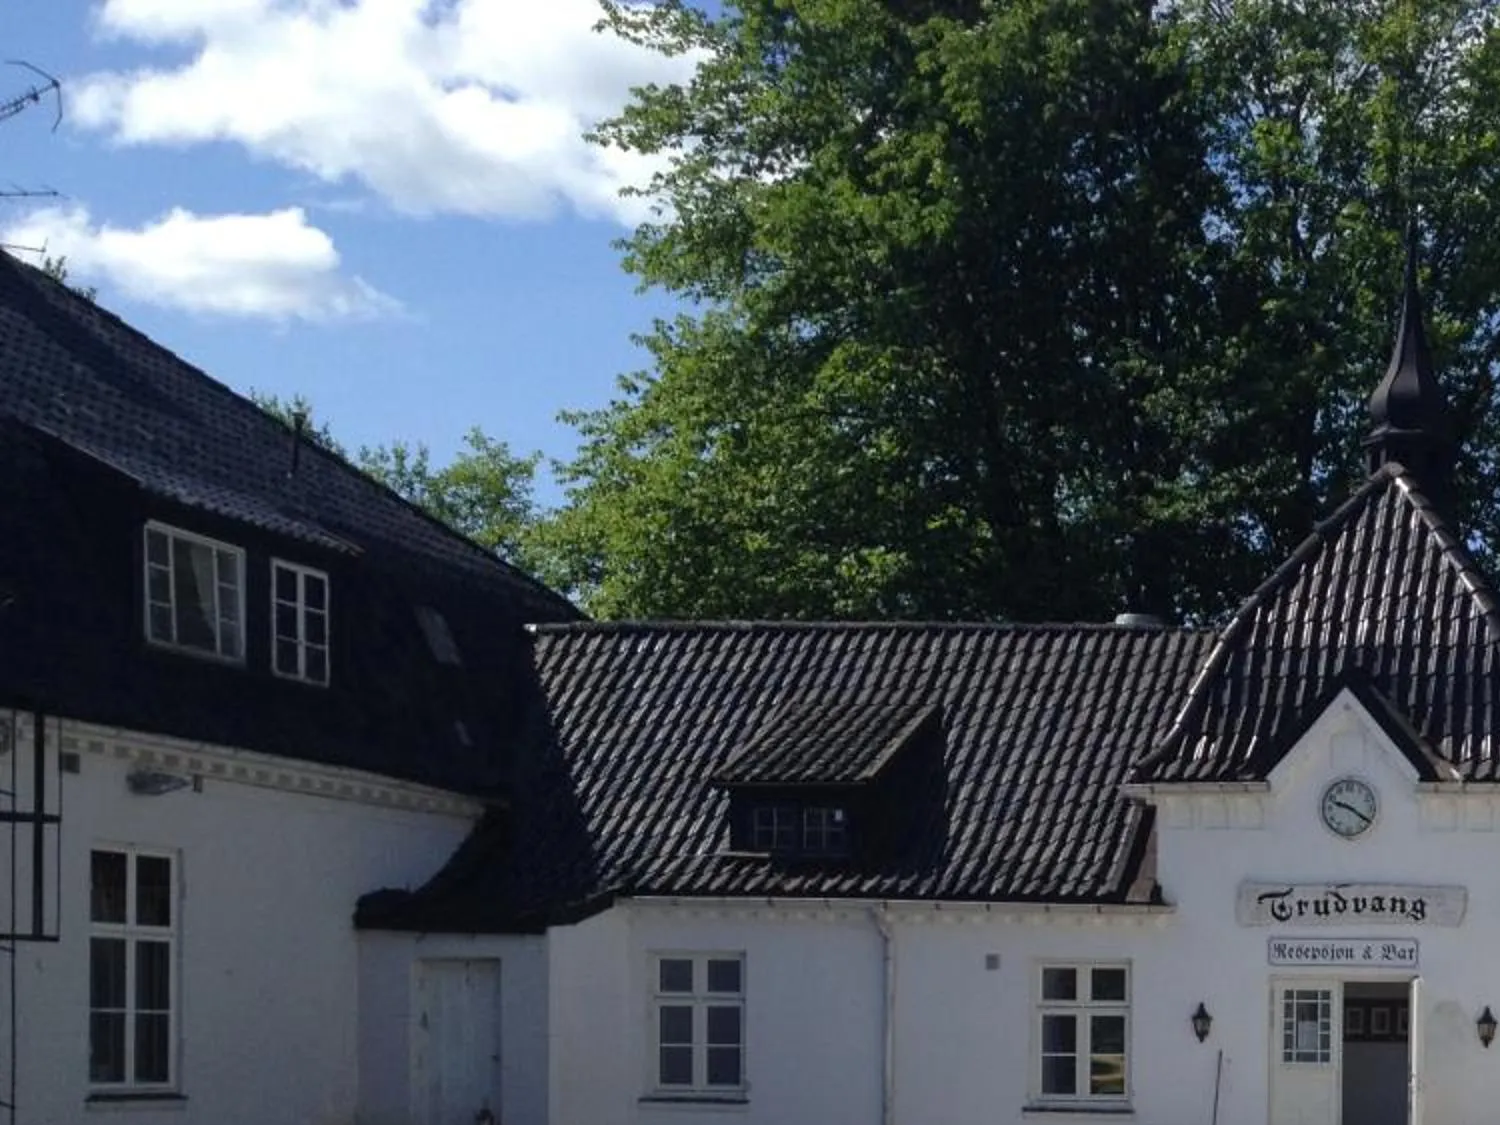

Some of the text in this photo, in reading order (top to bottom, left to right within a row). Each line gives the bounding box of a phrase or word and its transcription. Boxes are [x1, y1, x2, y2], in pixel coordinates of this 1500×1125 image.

[1256, 883, 1429, 923] Trudvang
[1362, 944, 1372, 960] &
[1382, 942, 1416, 961] Bar
